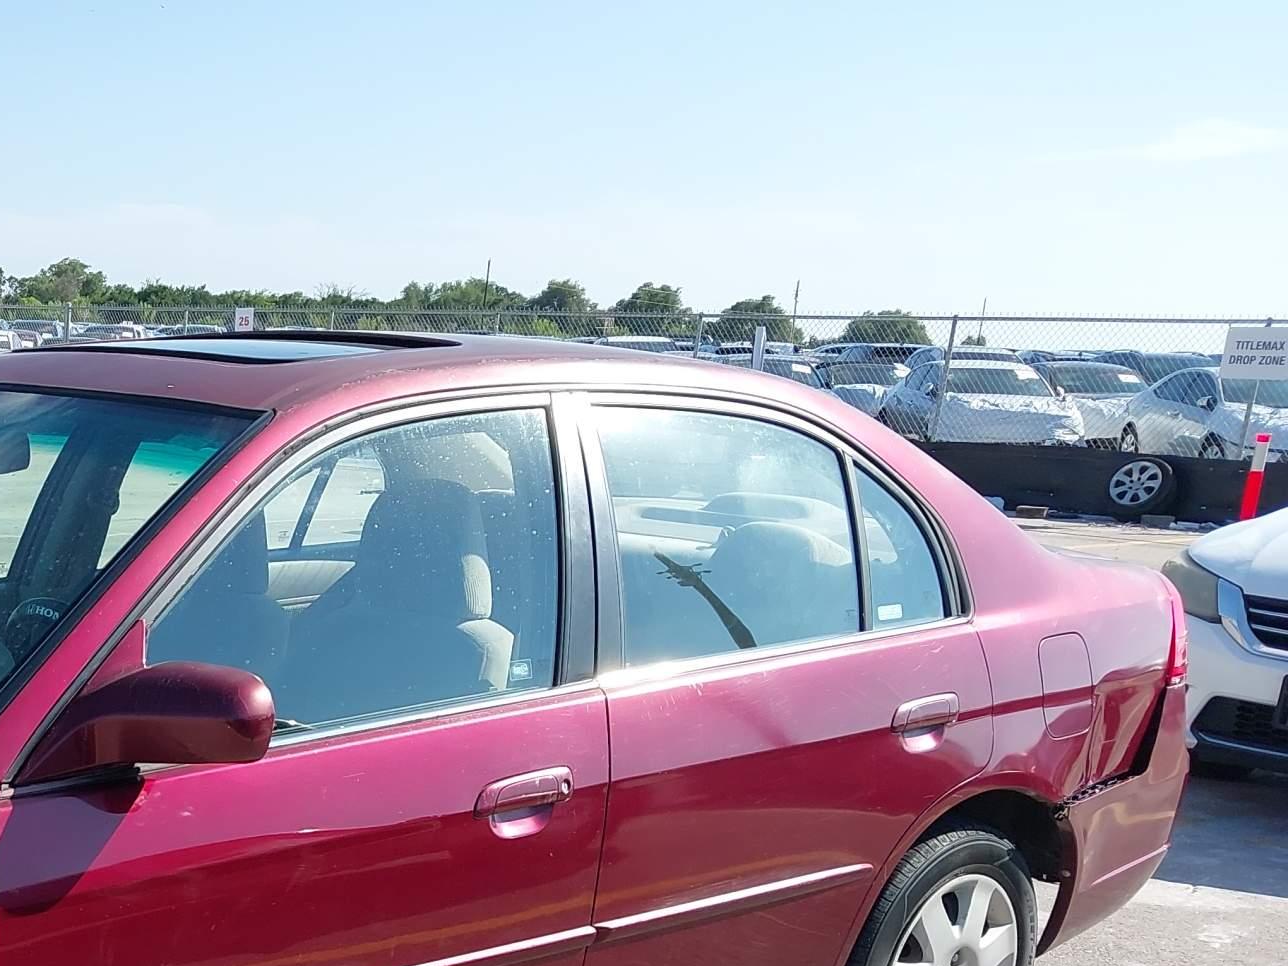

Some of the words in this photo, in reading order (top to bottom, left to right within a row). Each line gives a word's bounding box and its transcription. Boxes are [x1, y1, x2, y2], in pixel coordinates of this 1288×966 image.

[238, 316, 249, 326] 25
[1236, 340, 1286, 351] TITLEMAX
[1228, 355, 1257, 365] DROP
[1258, 355, 1286, 366] ZONE
